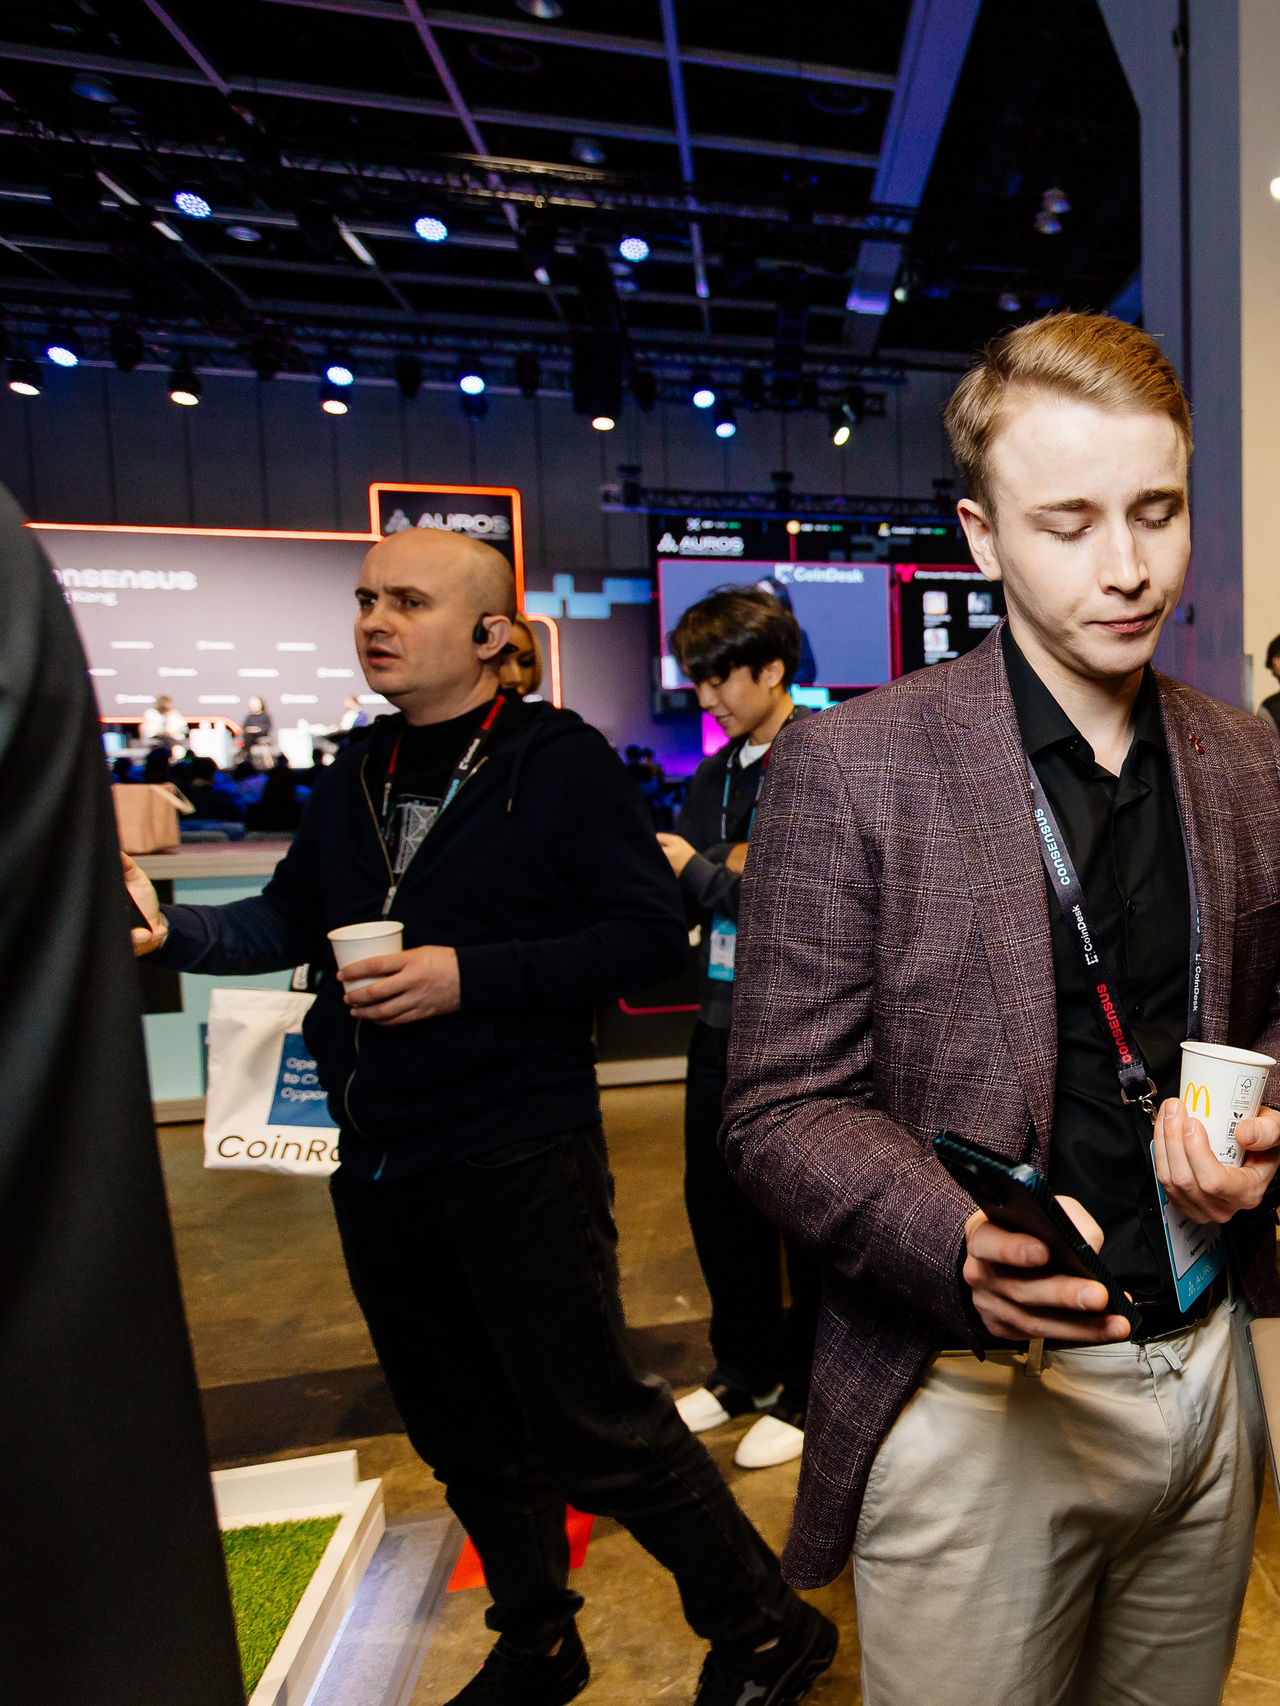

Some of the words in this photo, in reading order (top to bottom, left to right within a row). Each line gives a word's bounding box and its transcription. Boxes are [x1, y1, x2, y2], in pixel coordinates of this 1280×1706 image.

[416, 512, 510, 534] AUROS
[680, 535, 744, 552] AUROS
[1035, 807, 1071, 886] CONSENSUS
[1071, 904, 1096, 952] CoinDesk
[1192, 965, 1202, 1012] CoinDesk
[1096, 983, 1133, 1064] CONSENSUS
